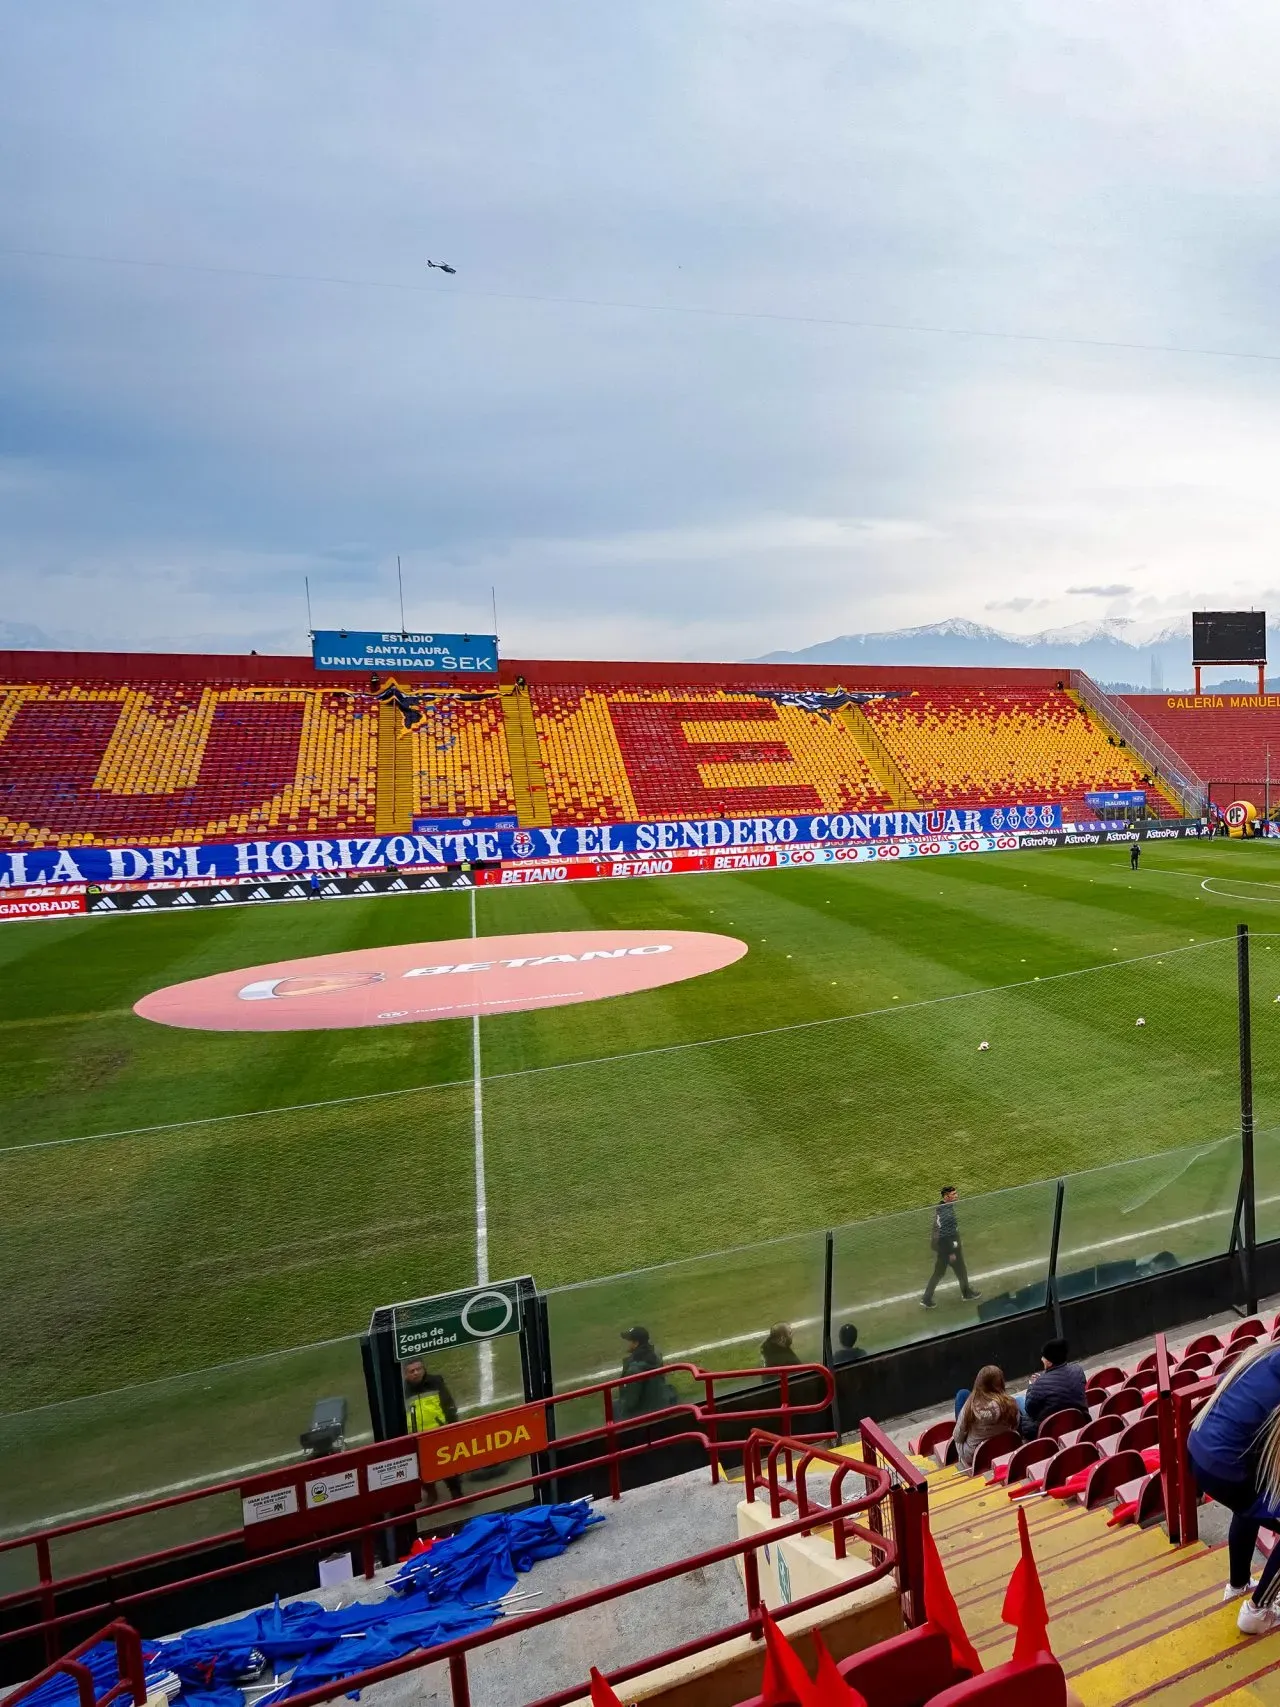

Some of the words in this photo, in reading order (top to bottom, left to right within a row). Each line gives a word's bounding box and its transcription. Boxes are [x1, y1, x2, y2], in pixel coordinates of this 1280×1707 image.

[381, 634, 434, 643] ESTADIO
[365, 645, 407, 654] SANTA
[410, 647, 450, 655] LAURA
[320, 656, 435, 667] UNIVERSIDAD
[441, 656, 493, 670] SEK
[1167, 694, 1224, 709] GALERÍA
[1229, 808, 1241, 823] PF
[1021, 836, 1057, 846] AstroPay
[1065, 834, 1100, 845] AstroPay
[1106, 831, 1140, 842] AstroPay
[1146, 829, 1179, 839] AstroPay
[106, 846, 216, 881] DEL
[234, 831, 503, 875] HORIZONTE
[538, 828, 566, 856] Y
[576, 825, 624, 854] EL
[636, 817, 798, 851] SENDERO
[809, 809, 983, 841] CONTINUAR
[612, 860, 673, 876] BETANO
[714, 853, 771, 869] BETANO
[501, 866, 568, 884] BETANO
[0, 901, 80, 914] GATORADE
[401, 944, 674, 979] BETANO
[400, 1331, 428, 1344] Zona
[430, 1327, 444, 1337] de
[400, 1334, 457, 1354] Seguridad
[436, 1425, 531, 1466] SALIDA
